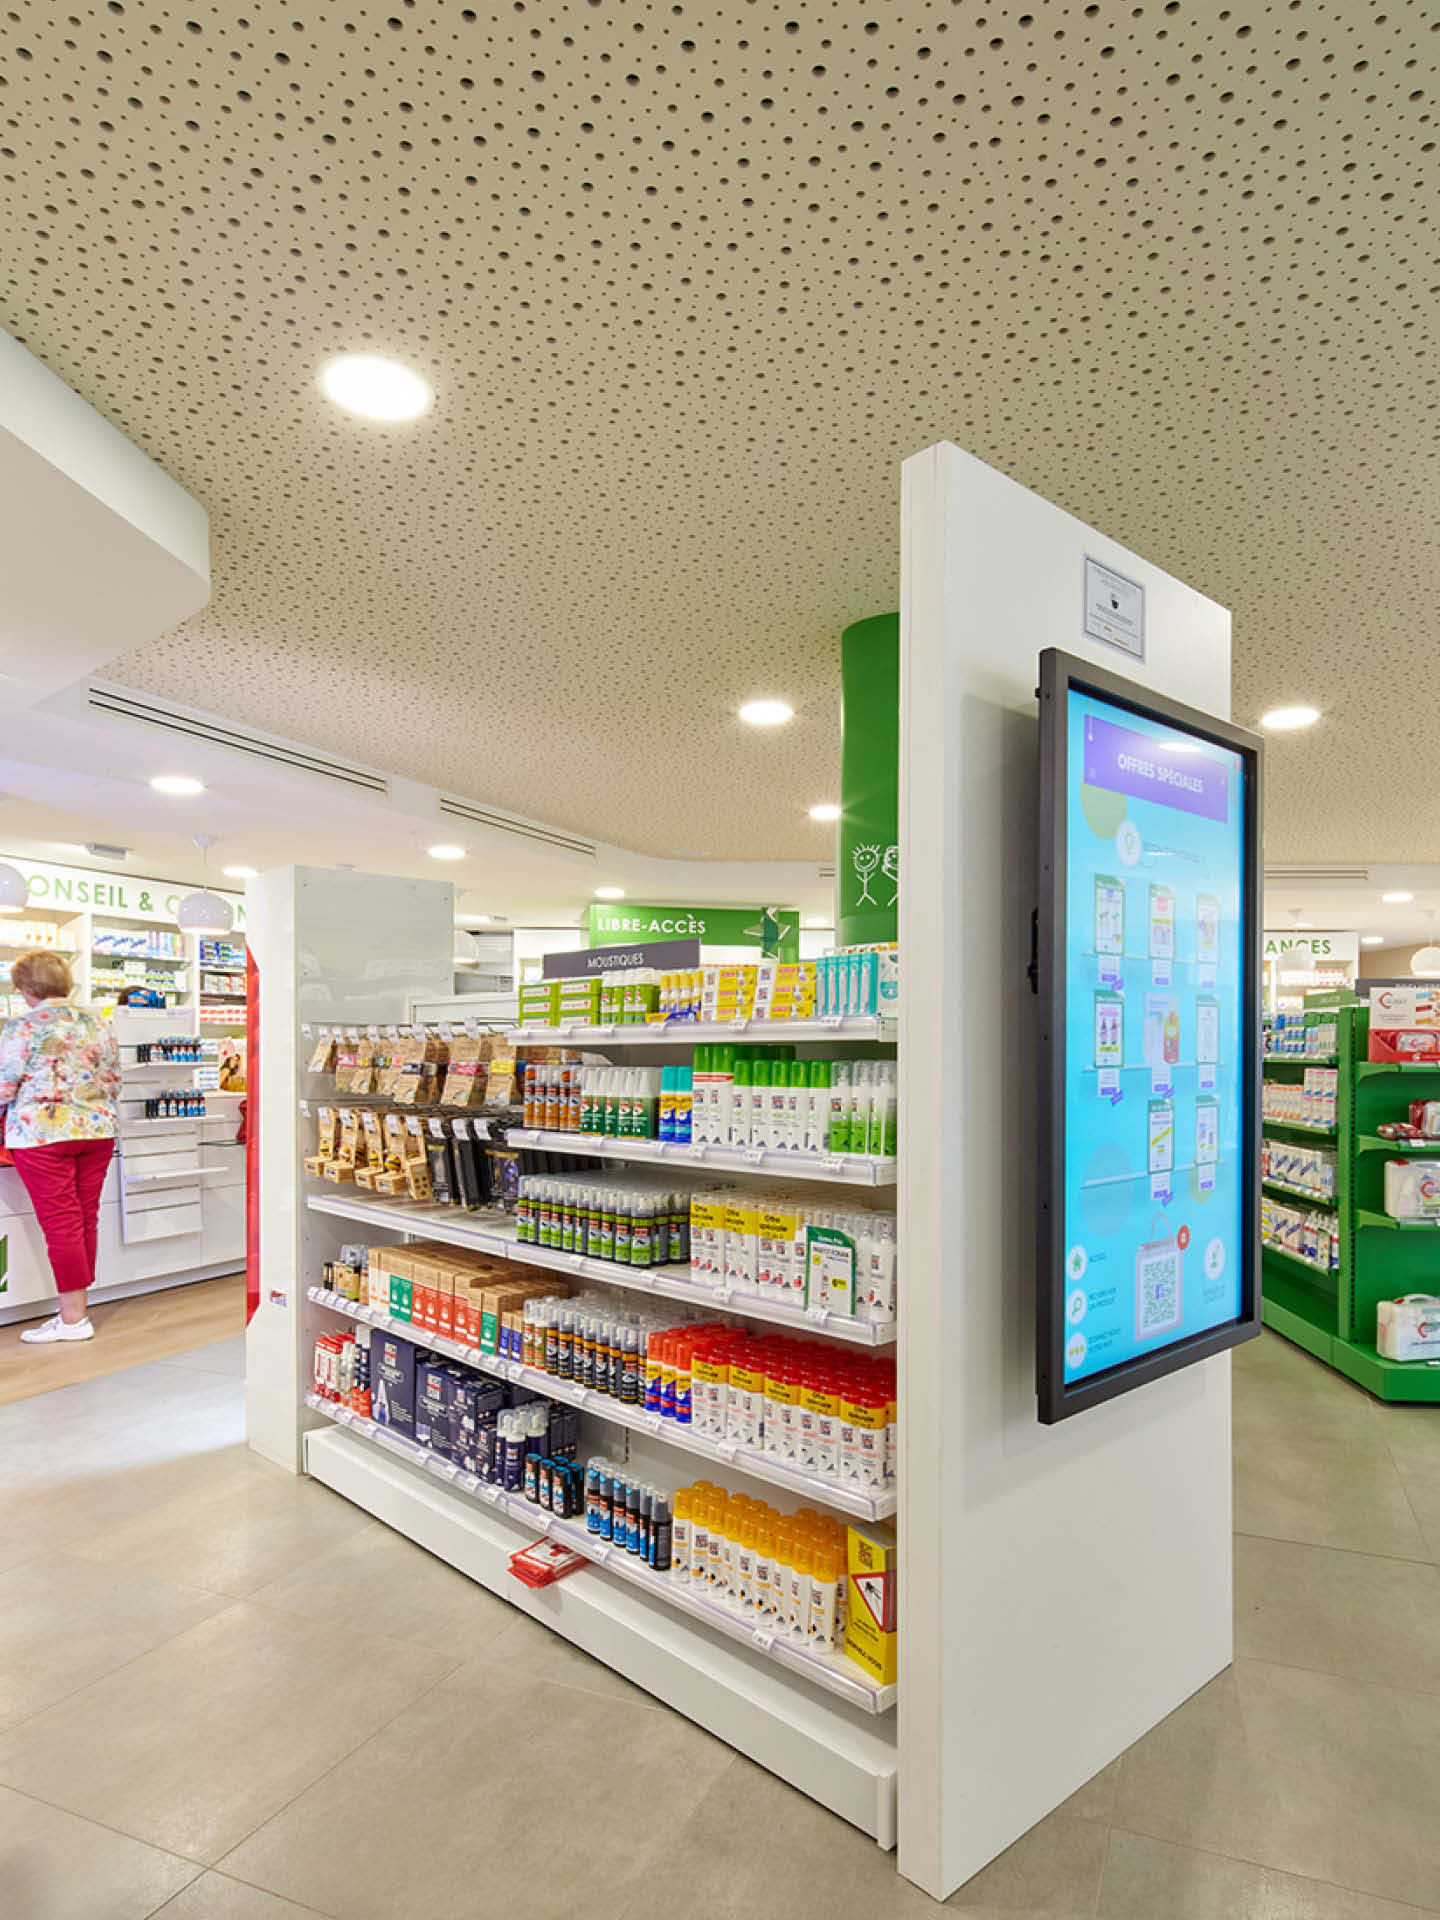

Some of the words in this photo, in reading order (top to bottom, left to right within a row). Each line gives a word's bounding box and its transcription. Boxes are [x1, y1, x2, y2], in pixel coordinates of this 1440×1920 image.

[1117, 753, 1155, 779] OFFRES
[26, 874, 129, 909] ONSEIL
[138, 891, 153, 912] &
[597, 913, 706, 934] LIBRE-ACCÈS
[586, 952, 645, 969] MOUSTIQUES
